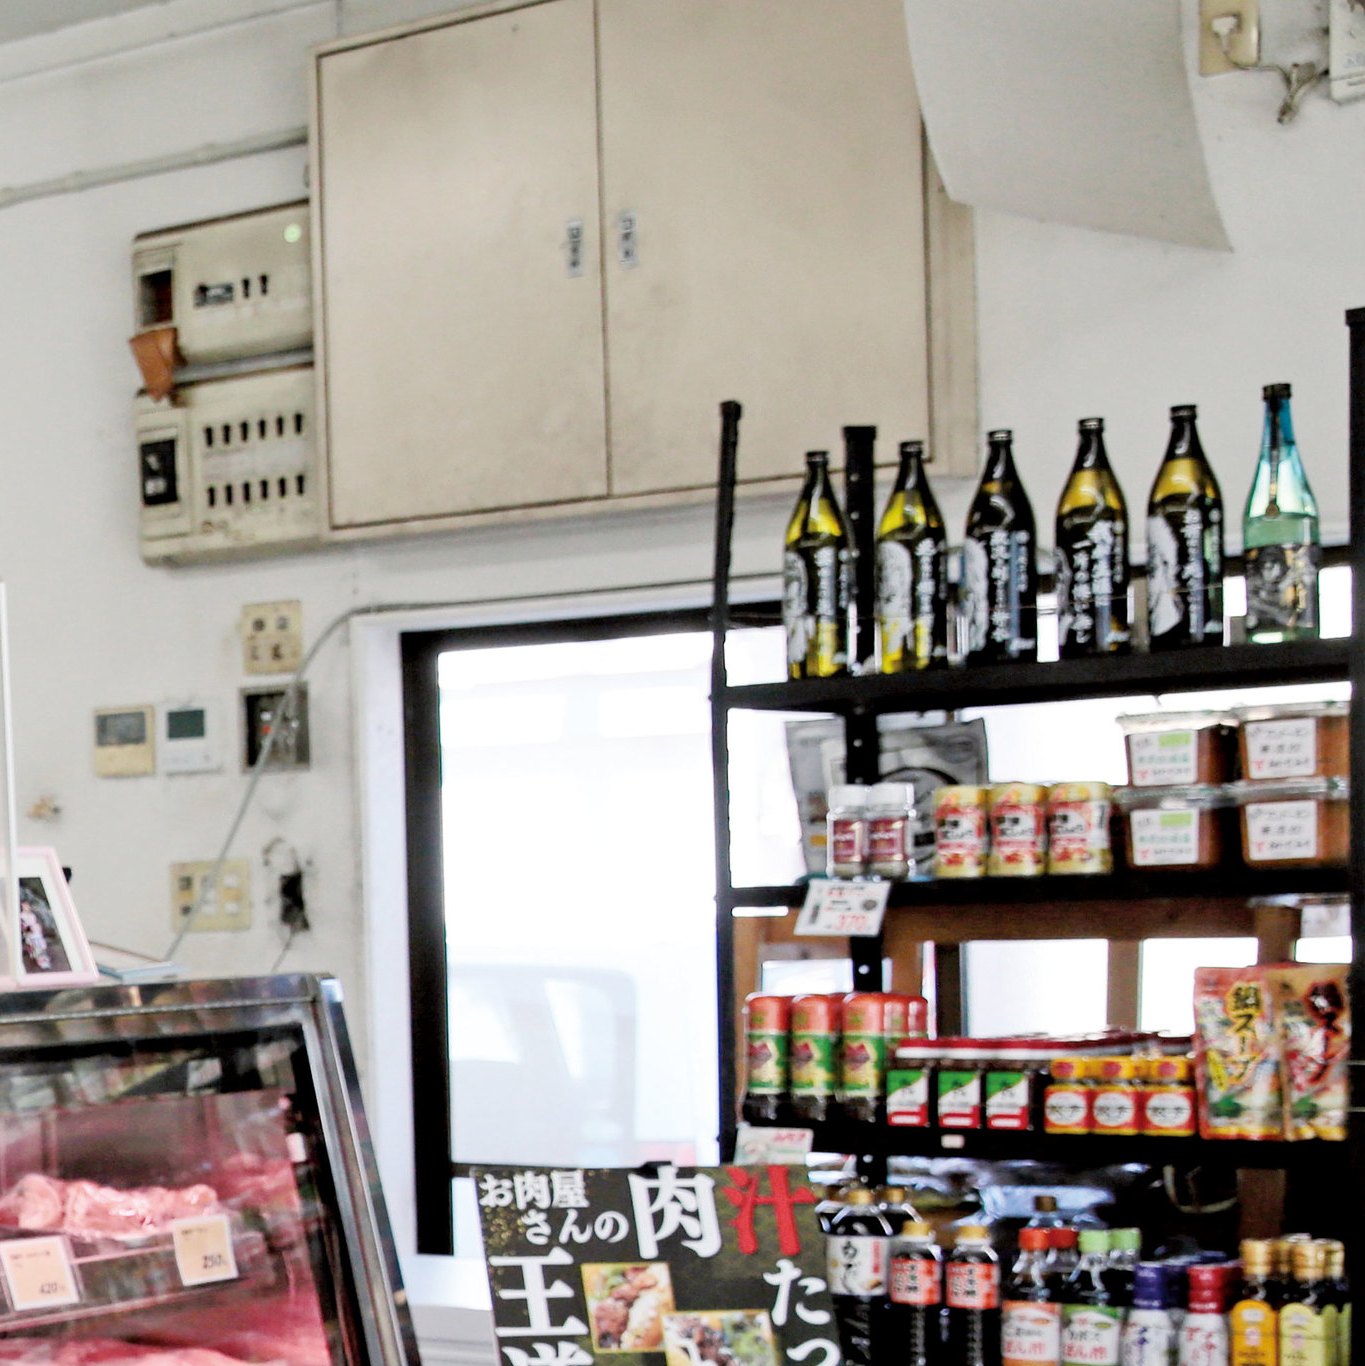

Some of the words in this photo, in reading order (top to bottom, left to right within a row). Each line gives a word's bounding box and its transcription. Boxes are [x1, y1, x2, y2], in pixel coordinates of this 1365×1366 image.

[478, 1169, 591, 1211] お肉屋
[523, 1210, 631, 1246] さんの
[626, 1163, 820, 1260] 肉汁
